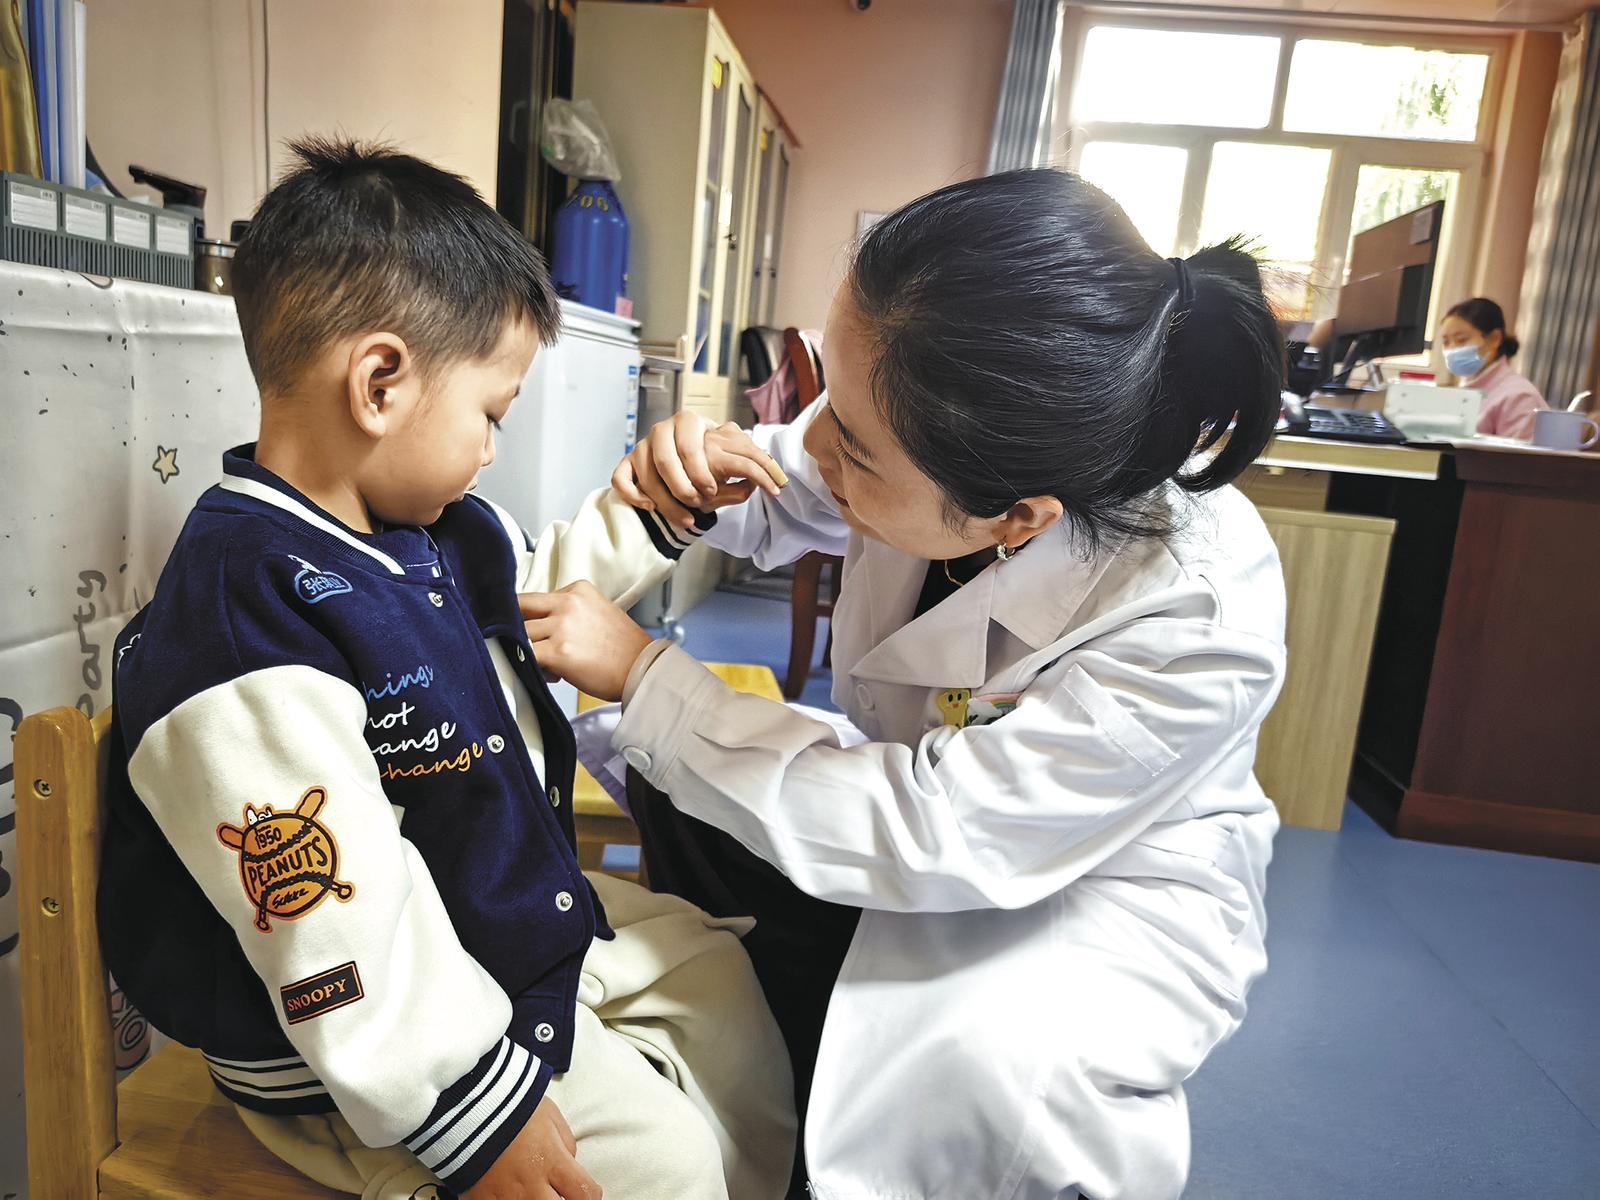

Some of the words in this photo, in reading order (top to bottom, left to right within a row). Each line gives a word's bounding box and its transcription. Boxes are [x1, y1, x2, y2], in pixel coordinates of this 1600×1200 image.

[363, 664, 434, 700] hings
[372, 722, 457, 755] ange
[380, 742, 484, 780] hange
[255, 827, 282, 850] 1950
[247, 835, 329, 894] PEANUTS
[286, 978, 347, 1012] SNOOPY
